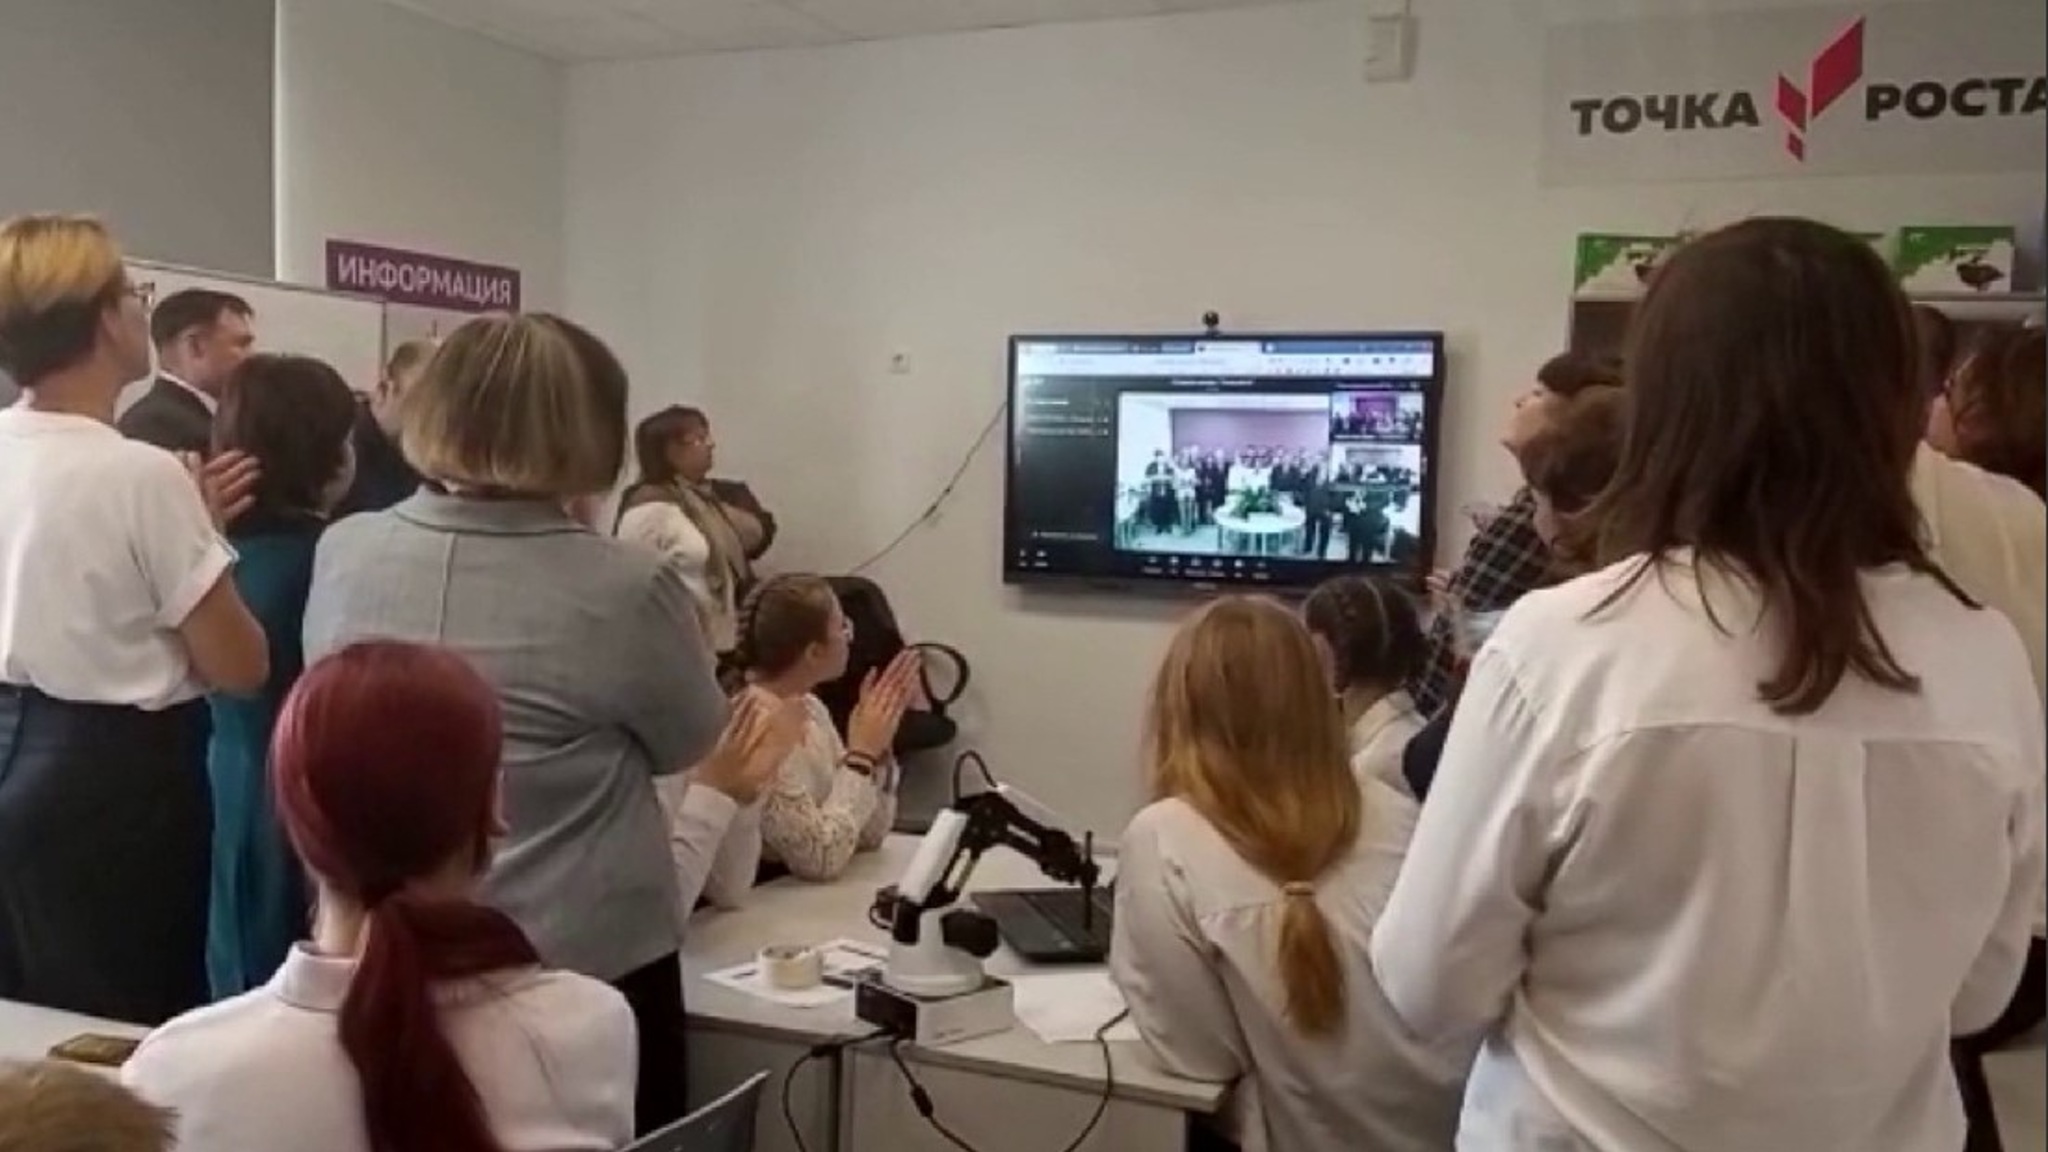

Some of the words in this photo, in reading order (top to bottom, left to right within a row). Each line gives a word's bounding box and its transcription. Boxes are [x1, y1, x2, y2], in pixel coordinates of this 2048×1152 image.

[1570, 91, 1759, 135] ТОЧКА
[1866, 77, 2046, 121] РОСТА
[337, 253, 512, 306] ИНФОРМАЦИЯ
